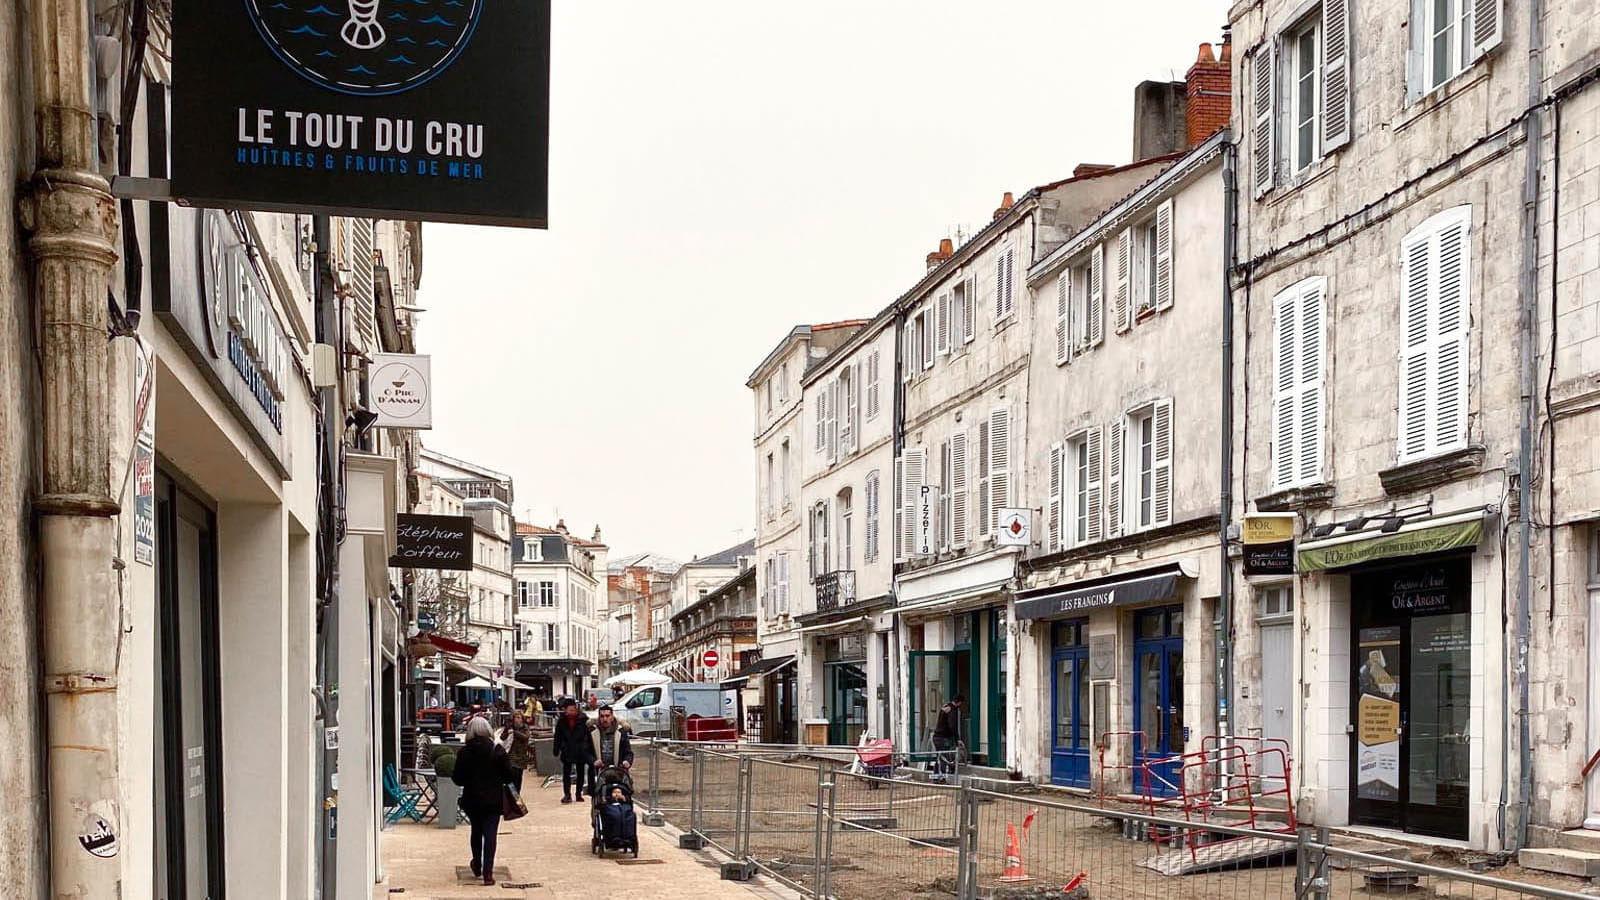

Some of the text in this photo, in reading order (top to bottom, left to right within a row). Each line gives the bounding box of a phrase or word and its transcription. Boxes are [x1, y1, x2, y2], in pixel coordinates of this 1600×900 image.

[239, 107, 483, 158] LE TOUT DU CRU
[237, 146, 482, 179] HUÎTRES & FRUITS DE MER
[397, 524, 464, 541] Stéphane
[920, 486, 930, 553] Pizzeria
[1060, 592, 1108, 611] LES FRANGINS
[1414, 594, 1446, 607] ARGENT
